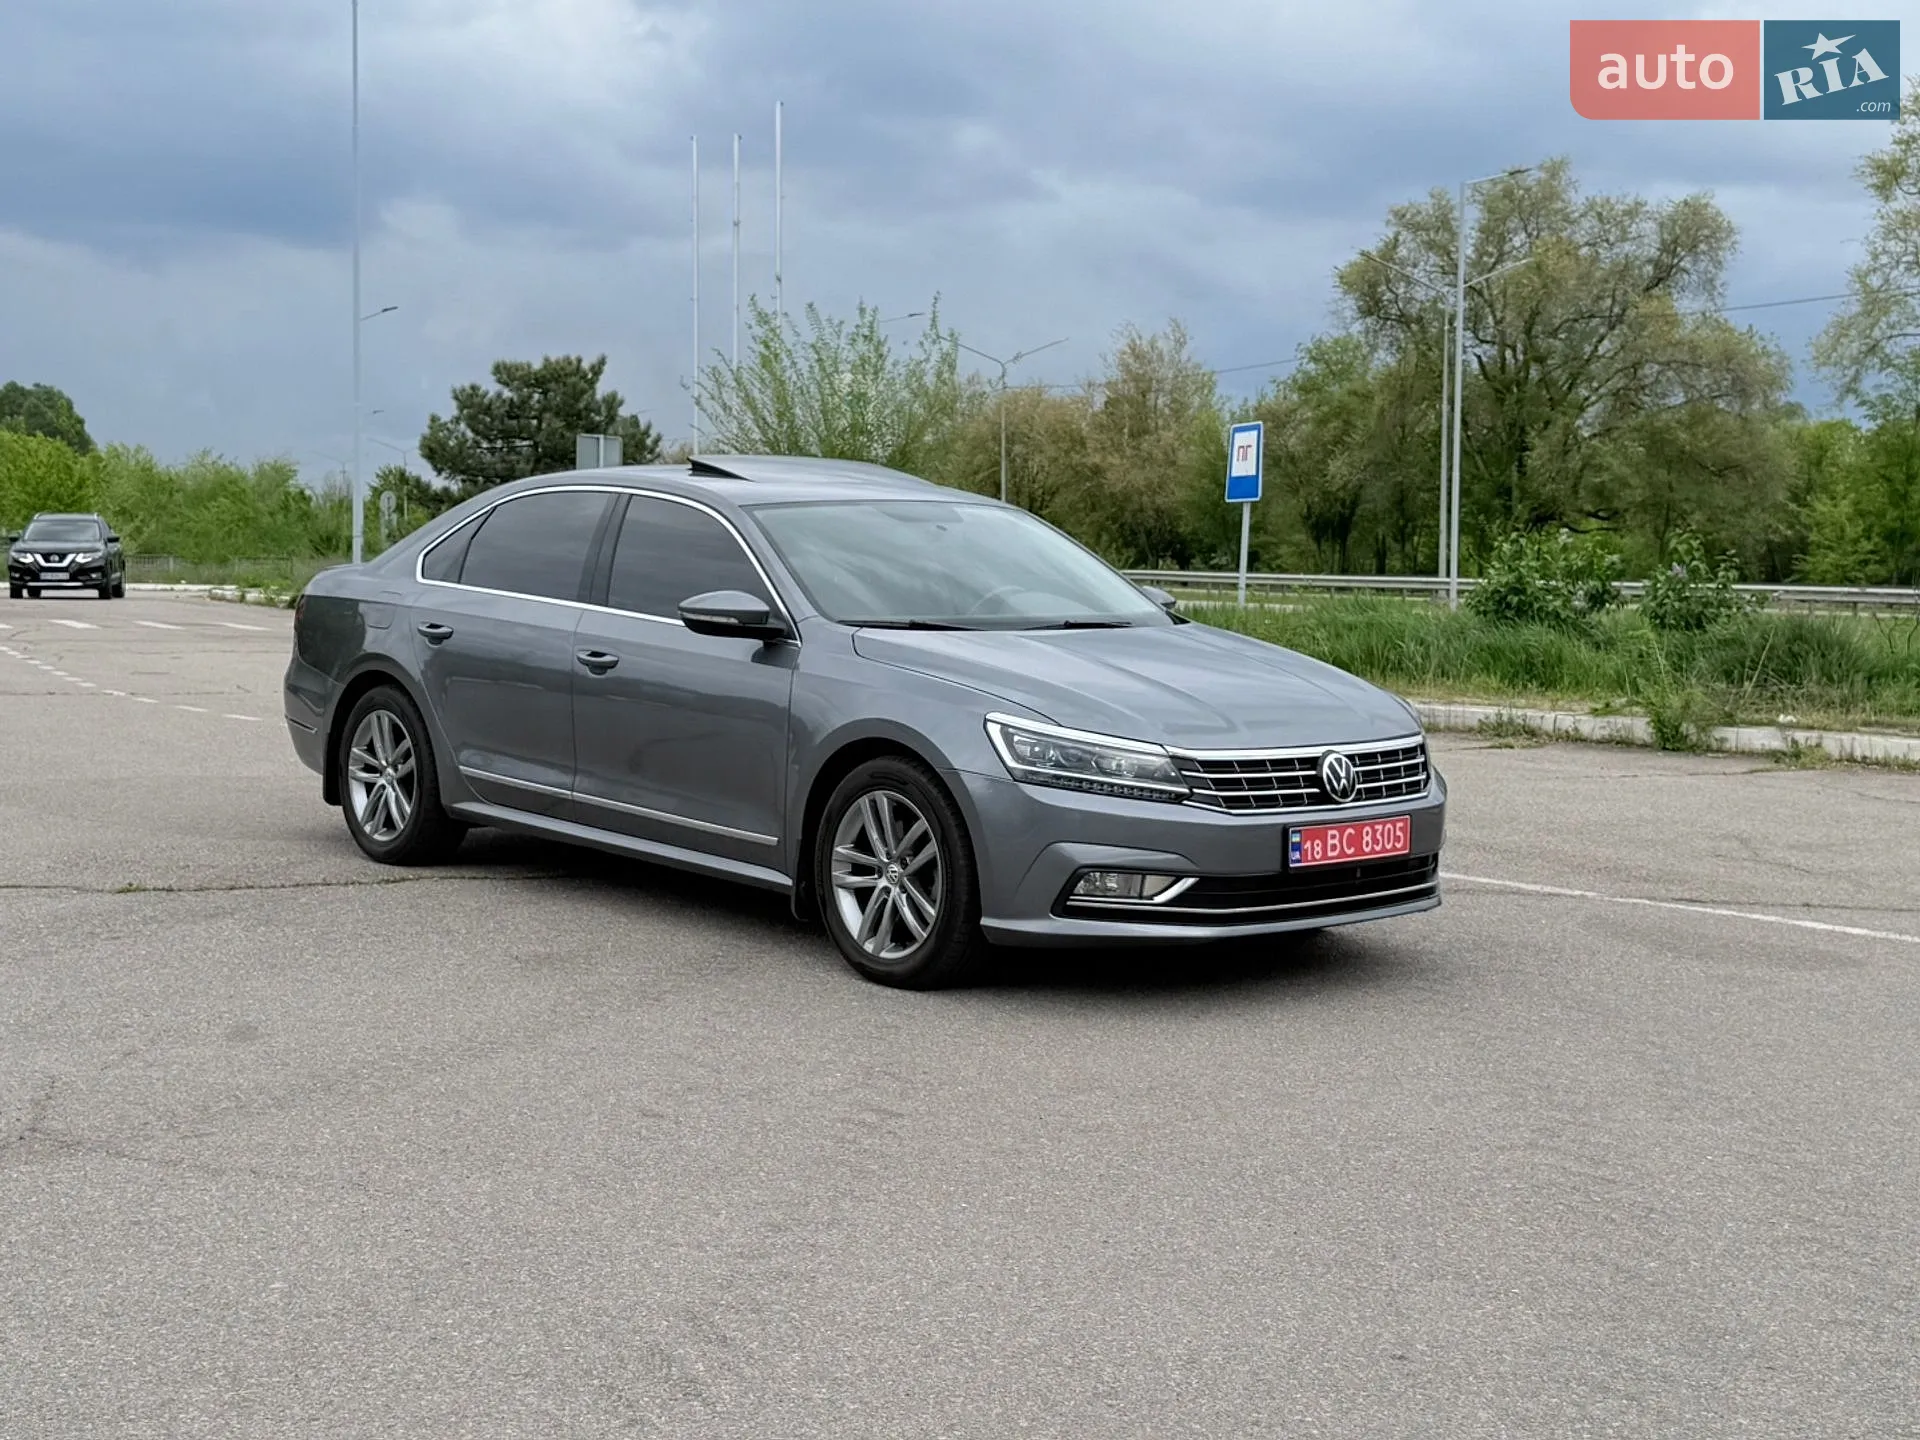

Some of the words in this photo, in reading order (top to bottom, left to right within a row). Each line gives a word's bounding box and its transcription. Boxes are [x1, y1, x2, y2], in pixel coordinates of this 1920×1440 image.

[1303, 839, 1322, 860] 18
[1327, 828, 1355, 857] BC
[1362, 822, 1404, 853] 8305
